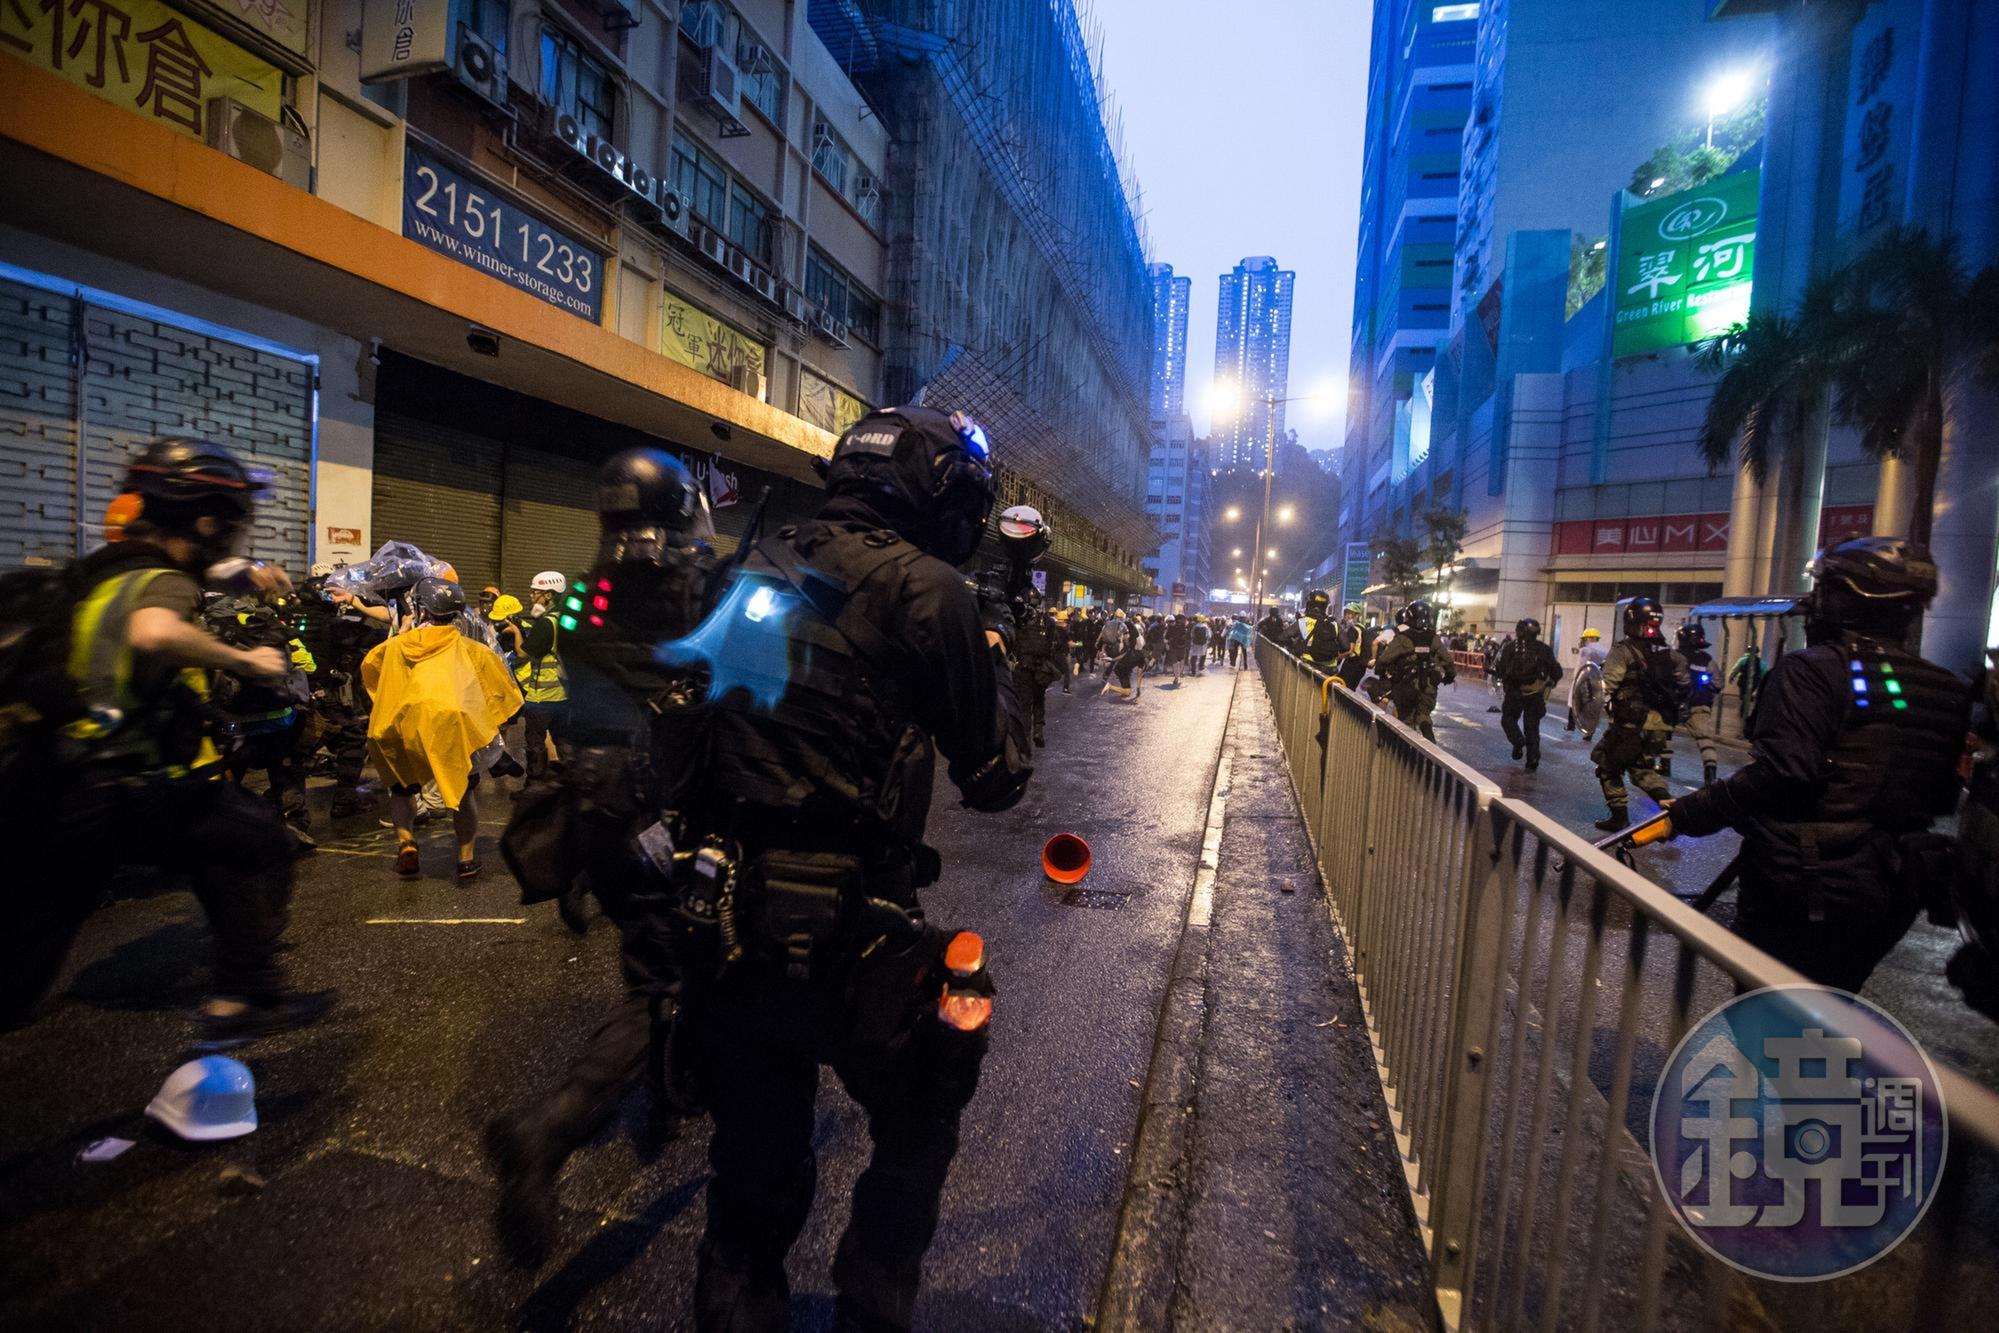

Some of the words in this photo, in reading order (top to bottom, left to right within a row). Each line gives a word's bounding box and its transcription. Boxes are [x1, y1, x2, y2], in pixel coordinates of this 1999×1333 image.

[0, 0, 213, 136] 你倉
[415, 166, 501, 248] 2151
[518, 224, 592, 293] 1233
[415, 220, 592, 317] www.winner-storage.com
[1627, 232, 1757, 298] 翠河
[1651, 299, 1682, 316] River
